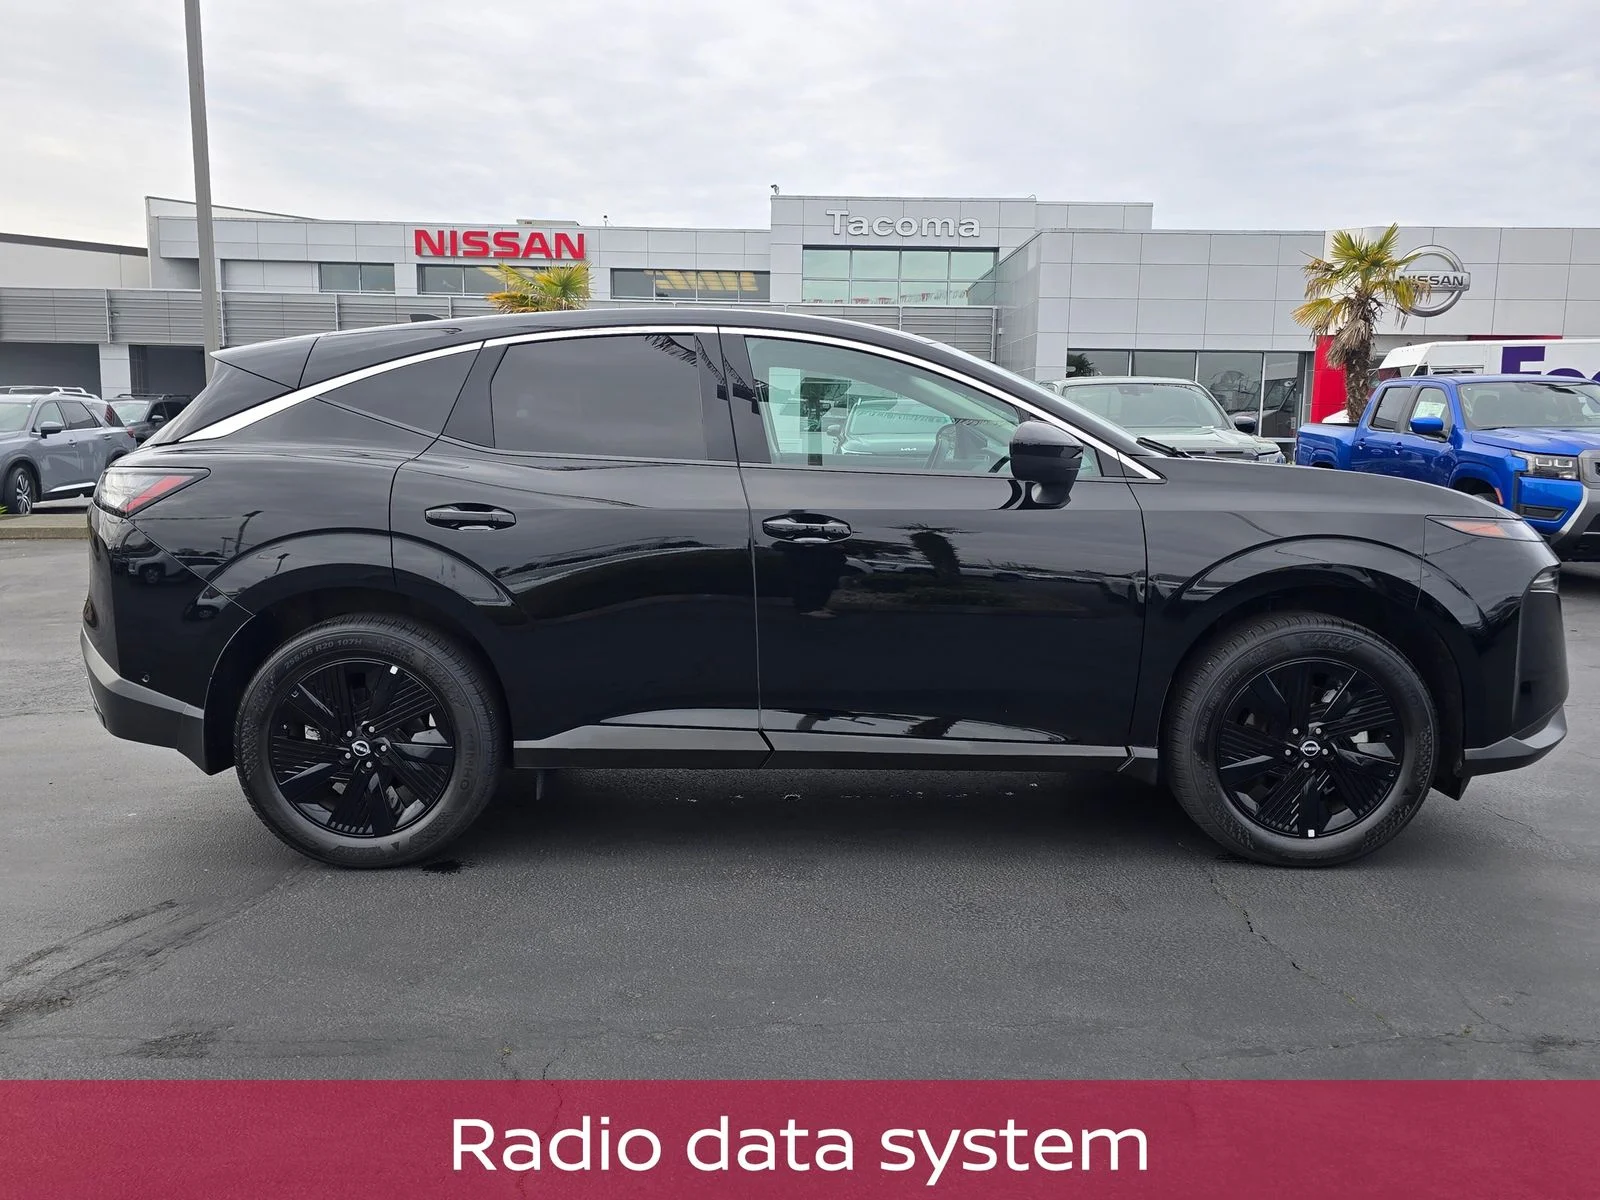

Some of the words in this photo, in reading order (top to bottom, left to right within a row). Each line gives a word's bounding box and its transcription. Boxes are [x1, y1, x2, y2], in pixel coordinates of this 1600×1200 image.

[826, 209, 980, 237] Tacoma
[415, 230, 585, 260] NISSAN
[1398, 275, 1464, 287] SSAN
